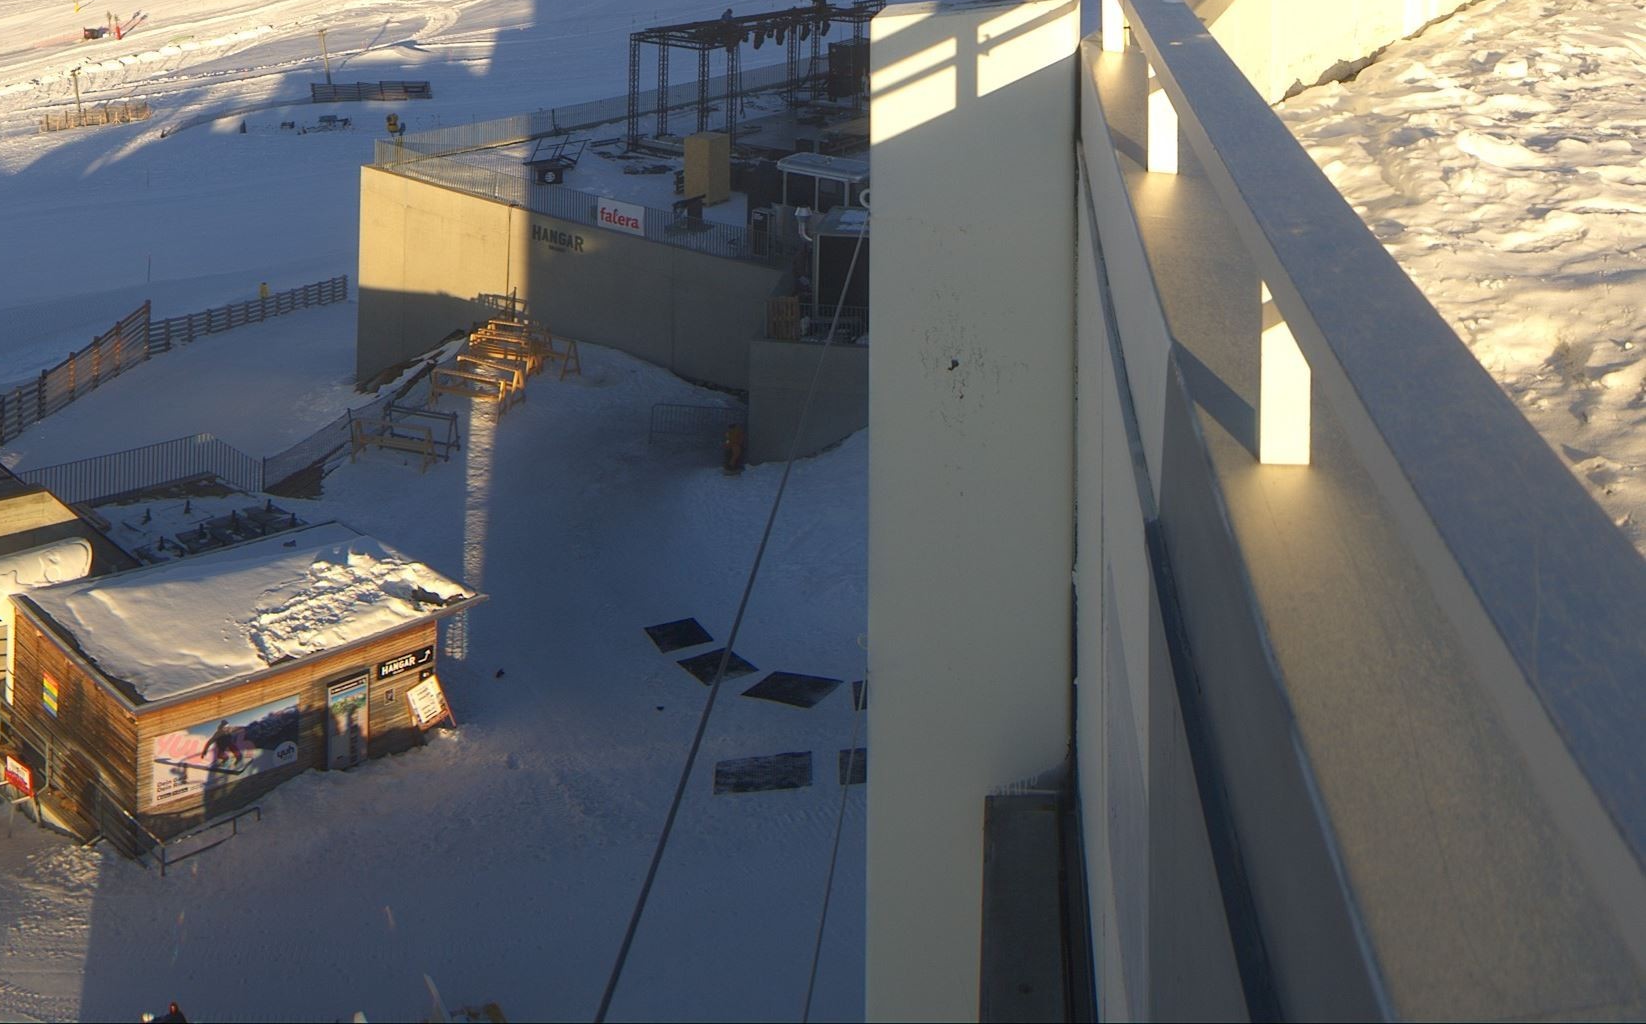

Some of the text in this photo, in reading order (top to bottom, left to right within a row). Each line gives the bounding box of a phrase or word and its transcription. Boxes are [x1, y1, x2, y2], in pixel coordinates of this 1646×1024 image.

[599, 206, 640, 229] falera
[531, 224, 584, 253] HANGAR
[381, 656, 416, 676] HANGAR
